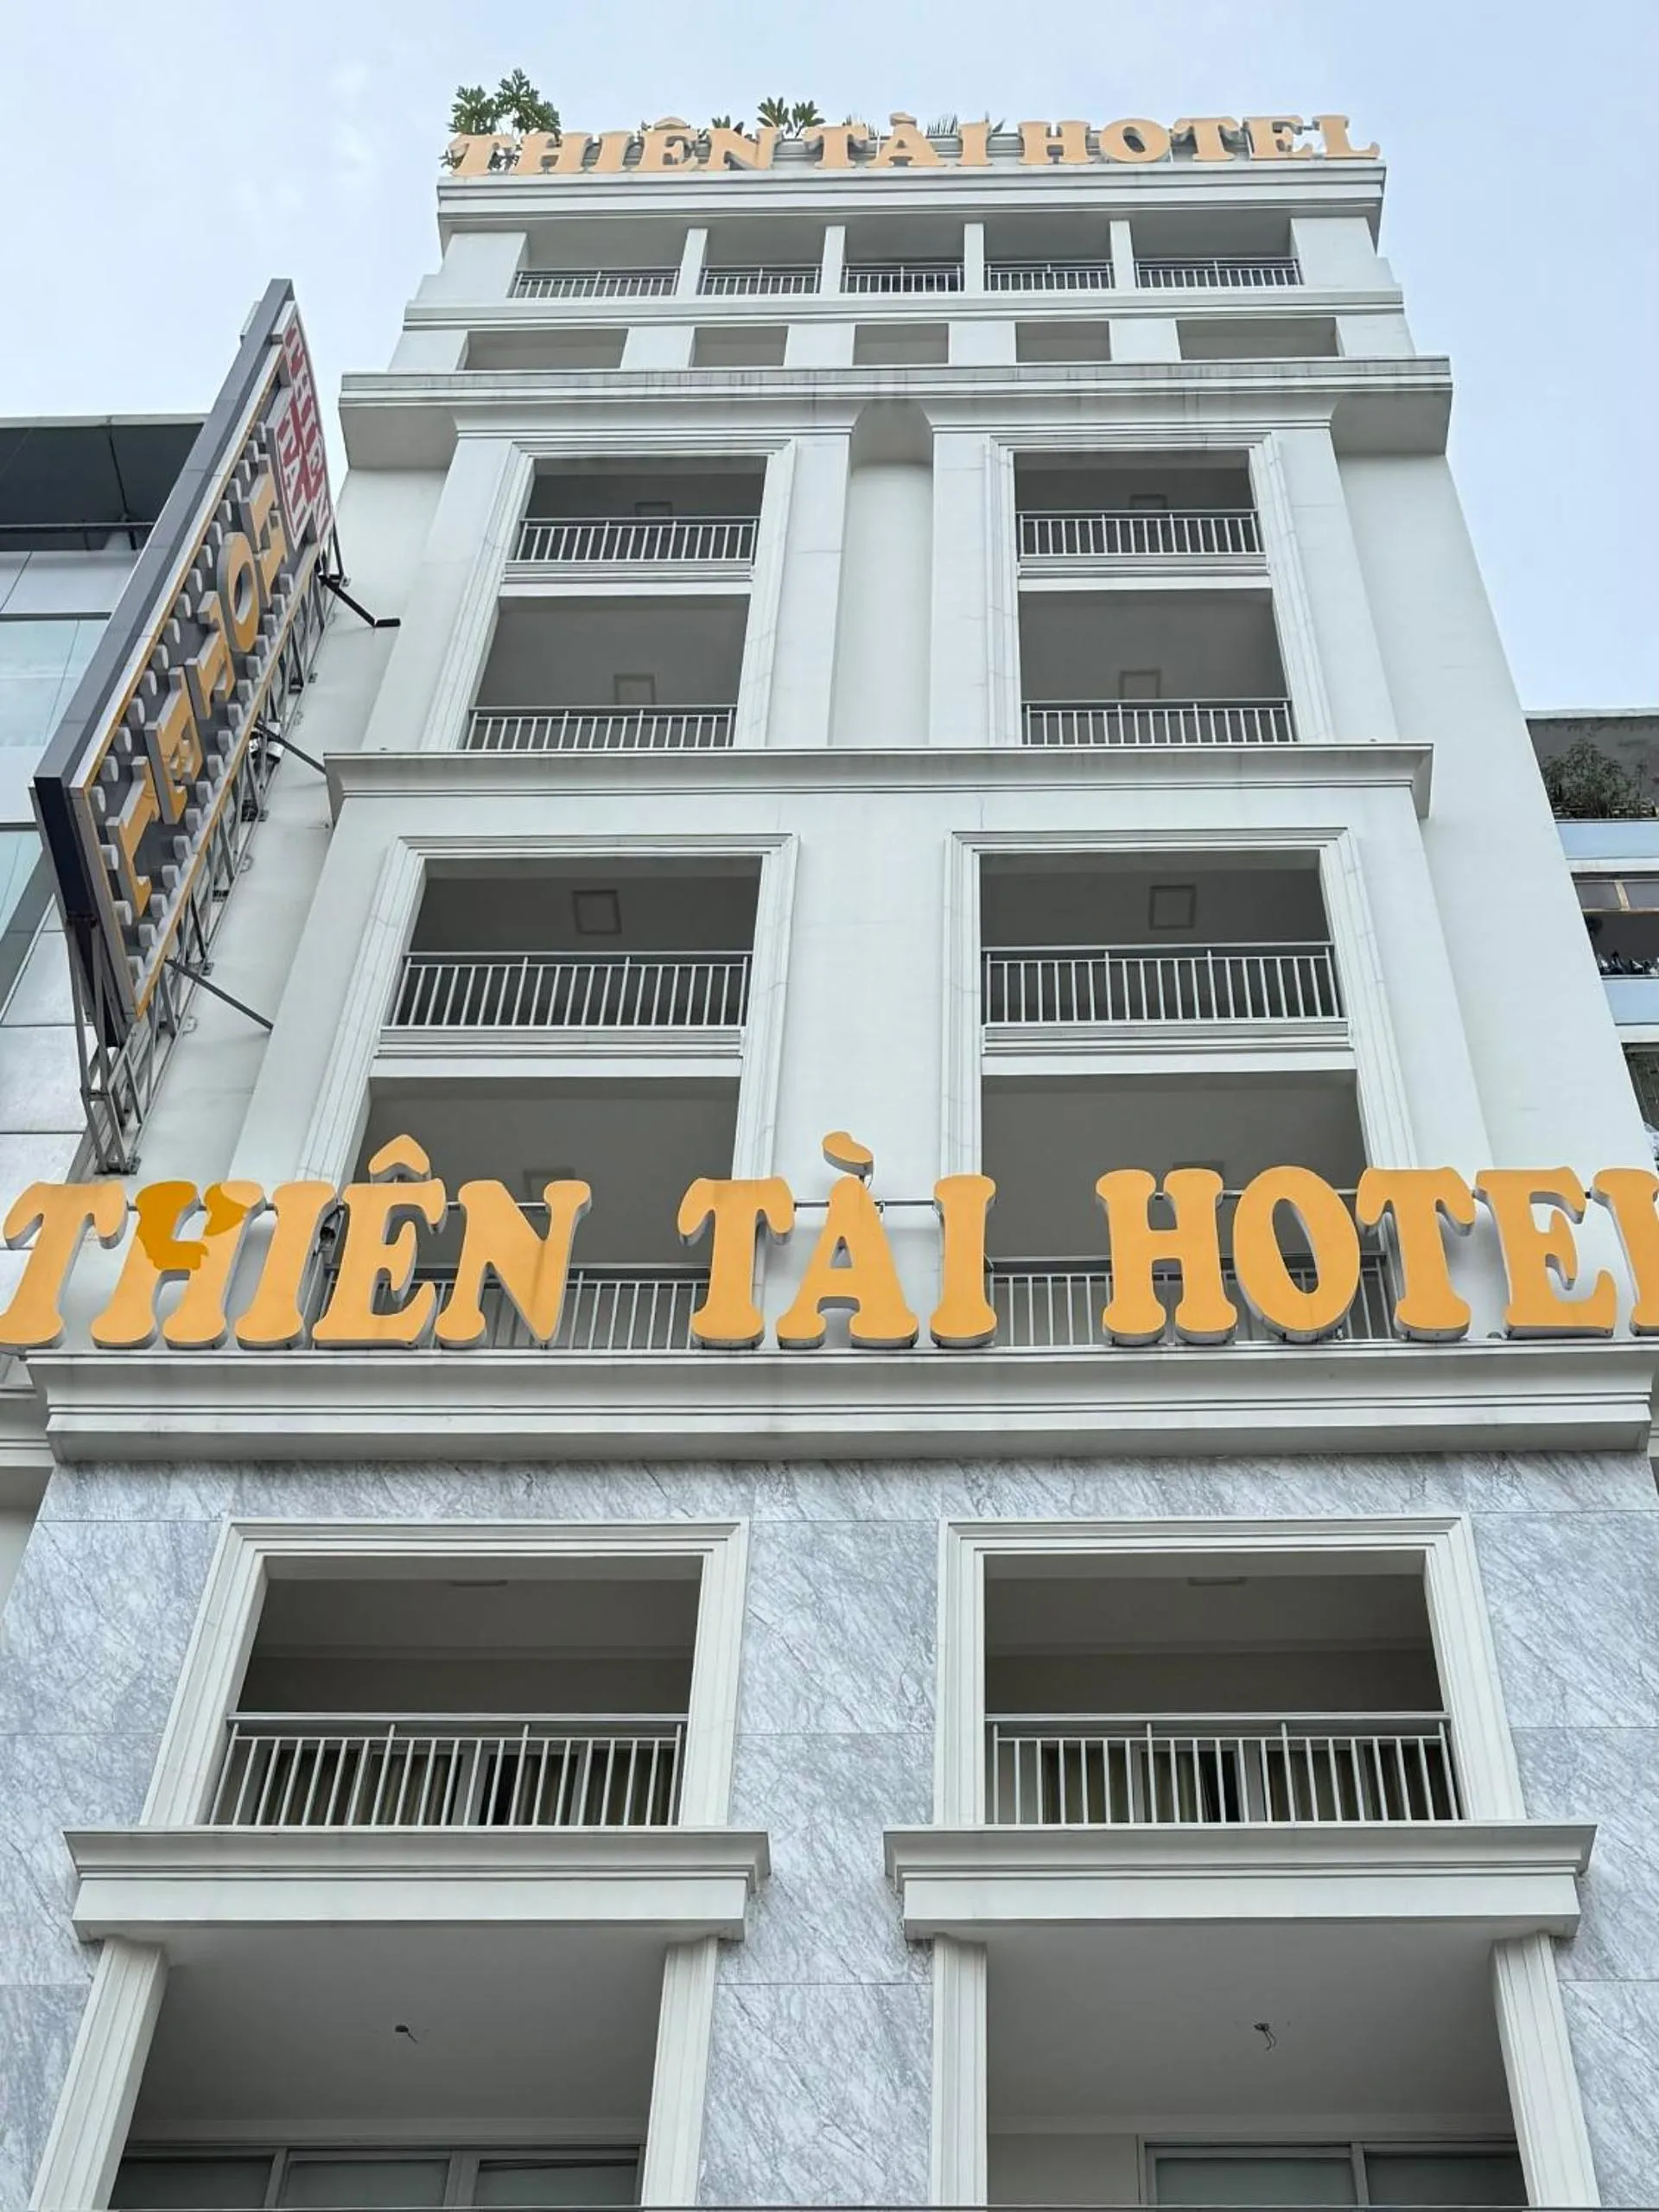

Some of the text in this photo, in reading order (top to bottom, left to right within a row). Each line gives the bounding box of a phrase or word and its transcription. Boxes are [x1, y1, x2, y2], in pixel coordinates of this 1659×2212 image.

[448, 112, 1380, 176] THIÊN TÀI HOTEL
[107, 452, 290, 918] HOTEL
[0, 1134, 593, 1350] THIÊN
[677, 1131, 996, 1348] TÀI
